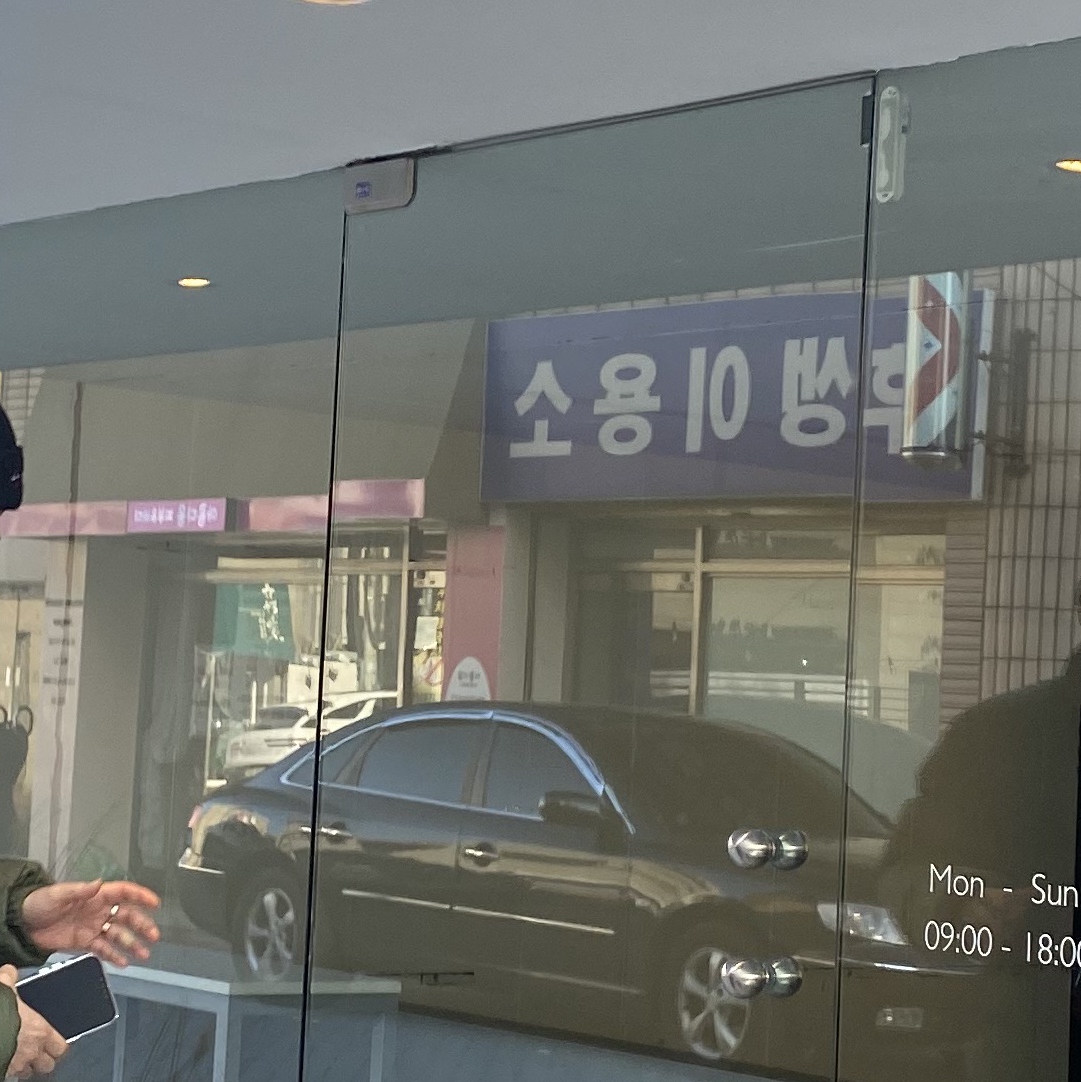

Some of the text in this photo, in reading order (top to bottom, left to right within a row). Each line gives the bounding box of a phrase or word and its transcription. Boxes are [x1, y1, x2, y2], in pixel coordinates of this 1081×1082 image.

[929, 863, 984, 898] Mon
[1031, 873, 1079, 908] Sun
[924, 920, 993, 957] 09:00
[1026, 931, 1081, 968] 18:0
